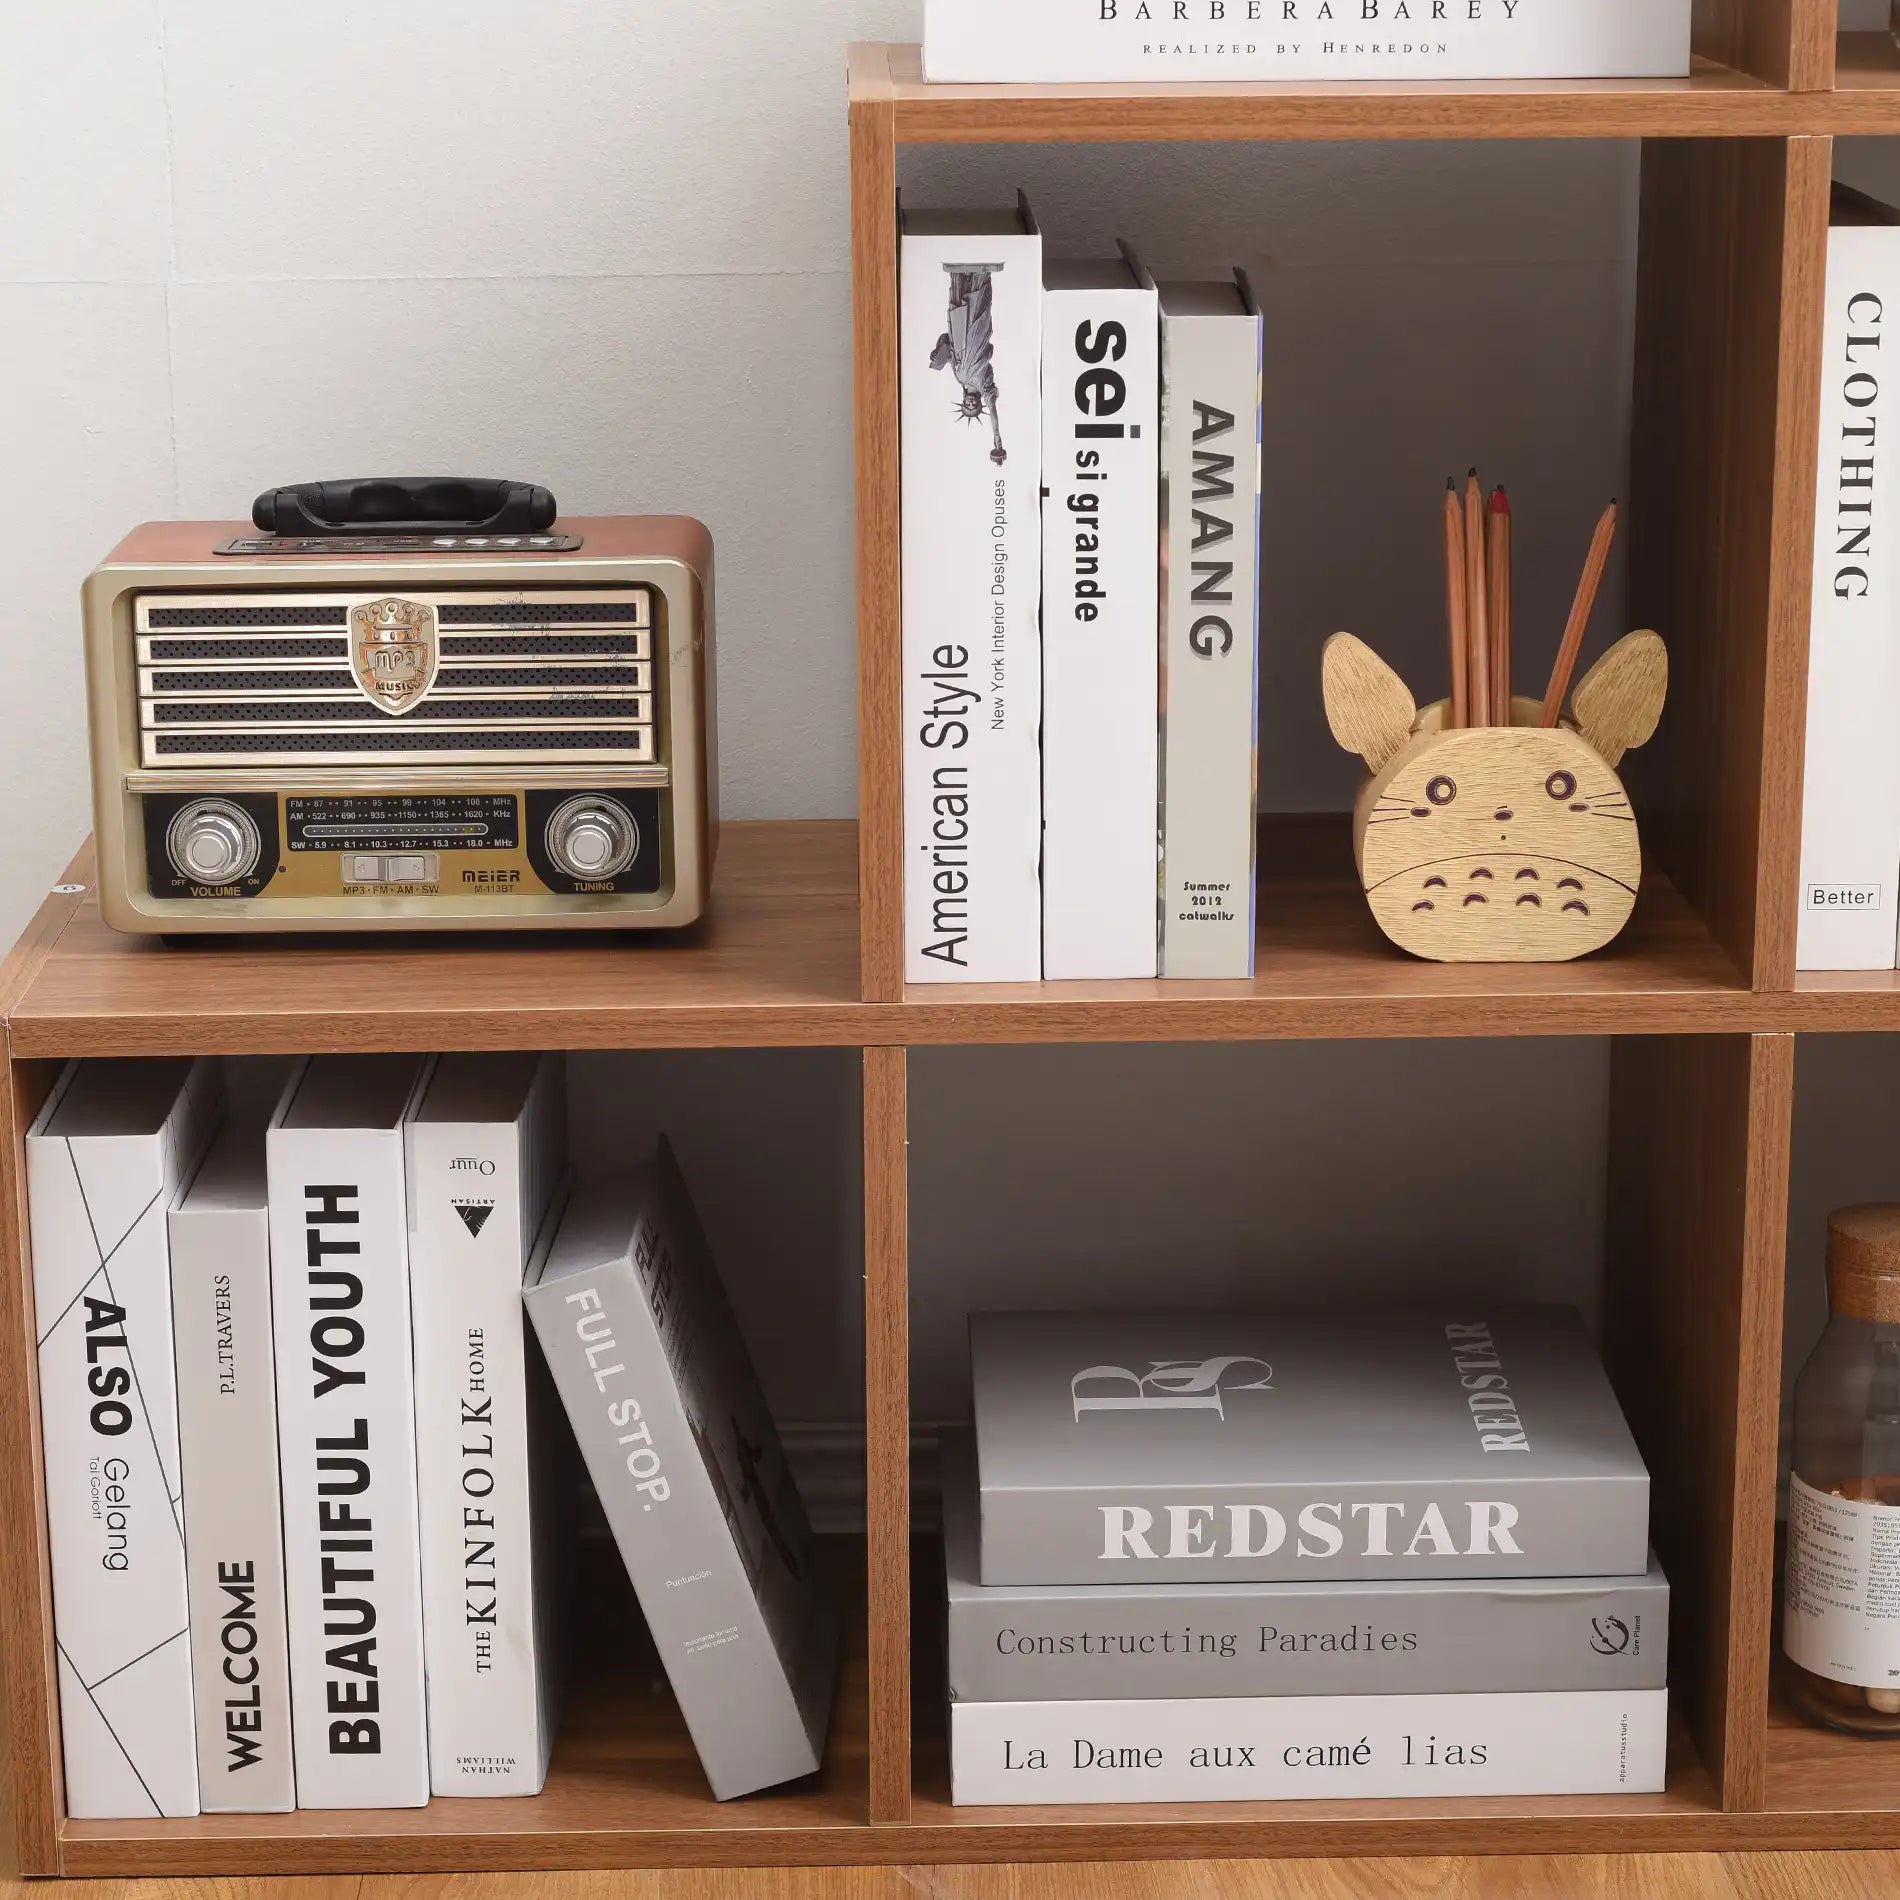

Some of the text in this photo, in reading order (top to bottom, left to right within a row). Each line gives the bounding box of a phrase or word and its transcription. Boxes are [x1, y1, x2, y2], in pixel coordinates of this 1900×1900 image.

[1098, 0, 1519, 20] BARBERA BAREY
[1143, 42, 1447, 54] REALIZED BY HENREDON
[1833, 291, 1884, 601] CLOTHING
[1066, 318, 1141, 622] sei si grande
[1189, 399, 1236, 660] AMANG
[991, 479, 1009, 730] New York Interior Design Opuses
[290, 800, 303, 808] FM
[343, 799, 353, 807] 91
[372, 799, 382, 807] 95
[919, 643, 982, 968] American Style
[312, 812, 327, 820] 522
[370, 811, 385, 819] 935
[398, 811, 417, 819] 1150
[464, 810, 483, 818] 1620
[493, 810, 511, 818] KHz
[291, 841, 305, 849] SW
[494, 839, 513, 847] MHz
[190, 886, 241, 897] VOLUME
[343, 885, 439, 895] MP3 FM AM SW
[474, 884, 514, 893] M-113BT
[573, 881, 615, 892] TUNING
[1183, 881, 1231, 892] Summer
[1191, 895, 1222, 906] 2012
[1813, 889, 1874, 905] Better
[1178, 910, 1235, 921] catwalks
[1445, 1321, 1531, 1453] REDSTAR
[565, 1288, 626, 1394] FULL
[607, 1398, 671, 1512] STOP.
[83, 1295, 134, 1571] ALSO Gelang
[304, 1184, 382, 1755] BEAUTIFUL YOUTH
[460, 1328, 497, 1674] THE KINFOLK HOME
[1097, 1501, 1525, 1560] REDSTAR
[996, 1624, 1418, 1658] Constructing Paradies
[217, 1560, 263, 1773] WELCOME
[456, 1757, 516, 1765] WILLIAMS
[1003, 1734, 1488, 1770] La Dame aux camé lias
[462, 1766, 511, 1774] NATHAN
